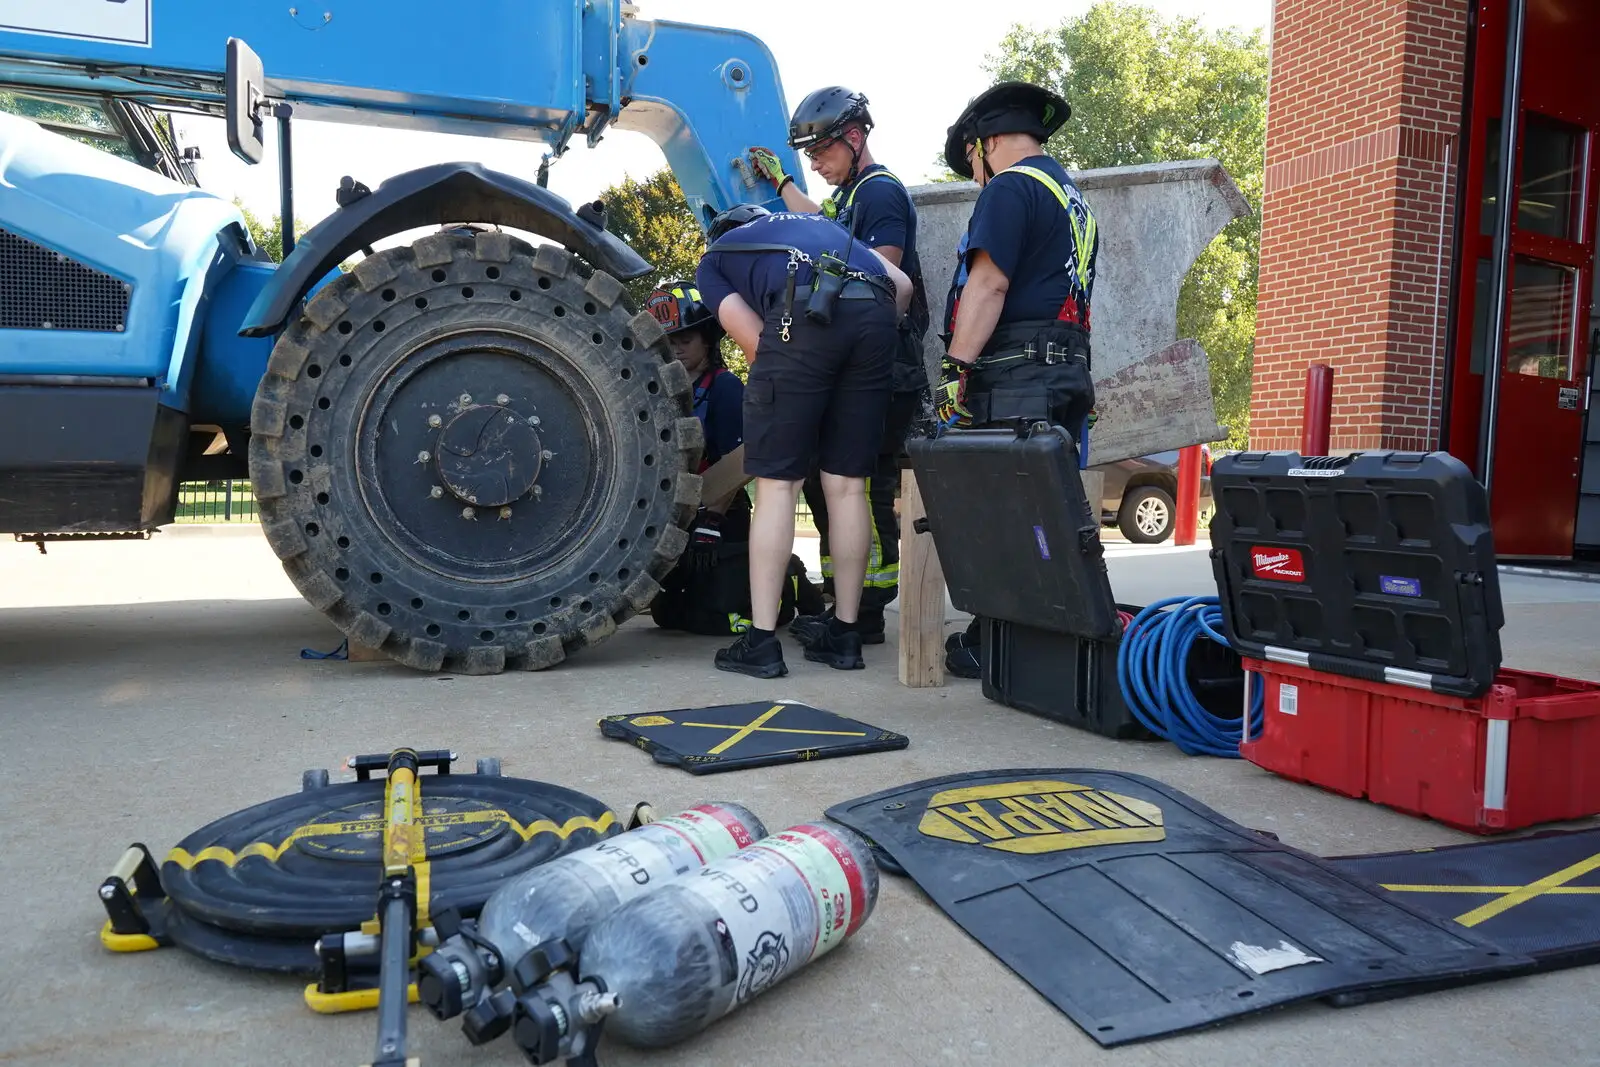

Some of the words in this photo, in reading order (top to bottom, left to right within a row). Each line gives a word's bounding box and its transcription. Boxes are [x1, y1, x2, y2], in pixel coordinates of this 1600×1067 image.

[1253, 553, 1290, 567] Milwaukee
[936, 790, 1152, 840] NAPA
[596, 843, 650, 885] VFPD
[833, 847, 851, 866] 5.5
[700, 867, 759, 913] VFPD
